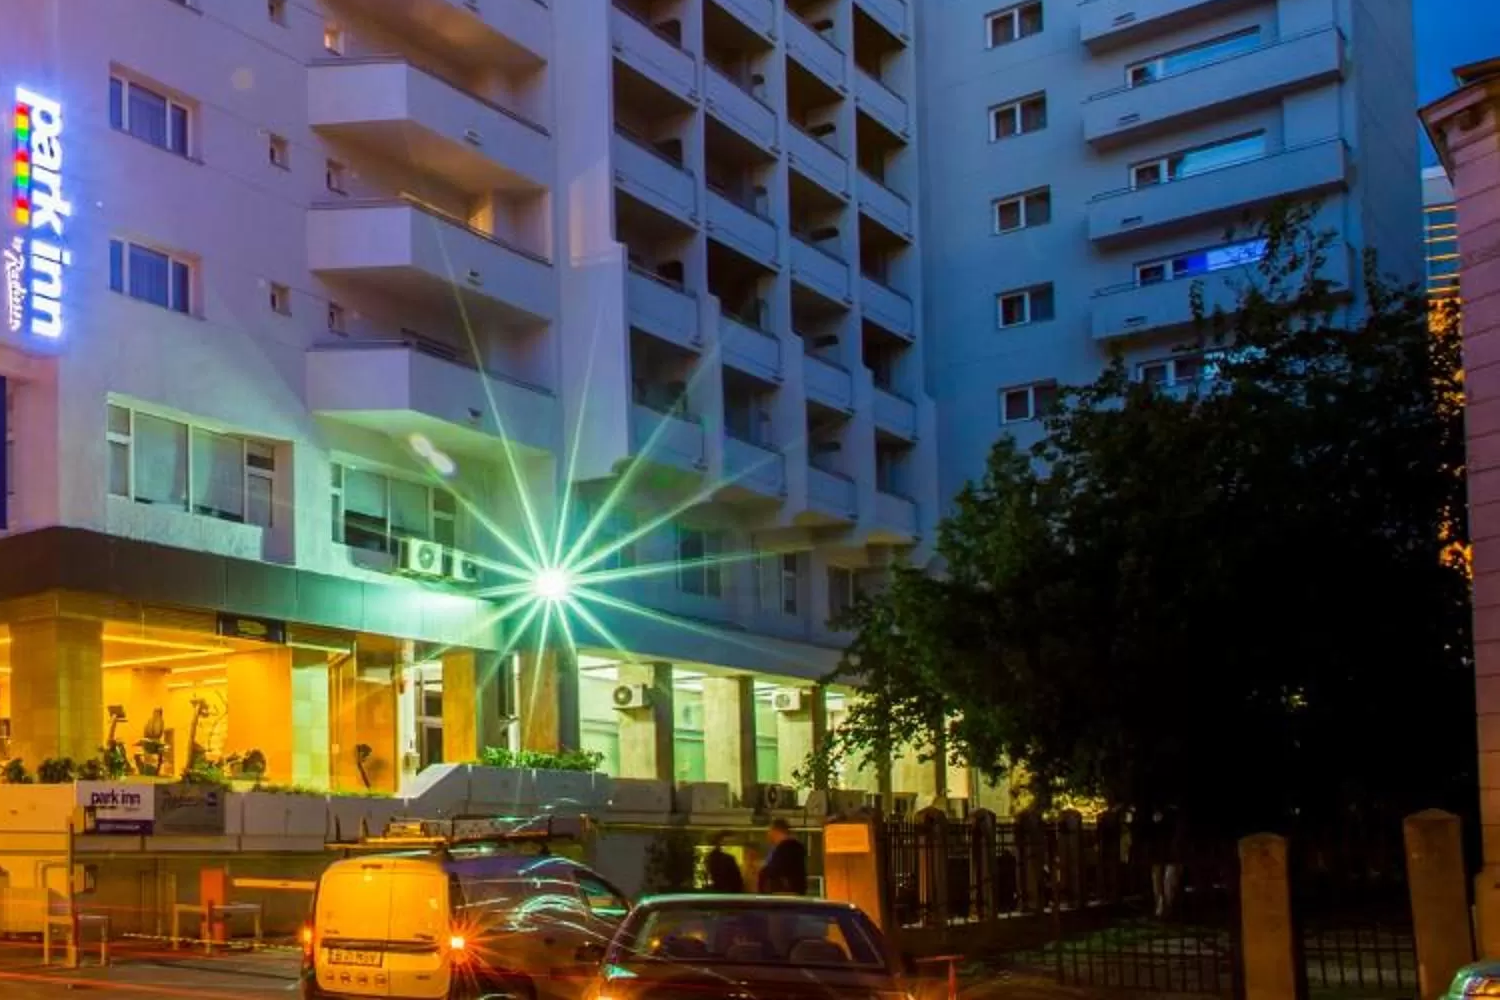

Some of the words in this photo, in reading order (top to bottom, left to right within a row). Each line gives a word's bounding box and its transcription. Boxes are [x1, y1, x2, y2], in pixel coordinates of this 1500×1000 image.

[15, 86, 71, 236] park
[31, 239, 71, 338] inn
[91, 788, 118, 806] park
[121, 789, 141, 805] inn
